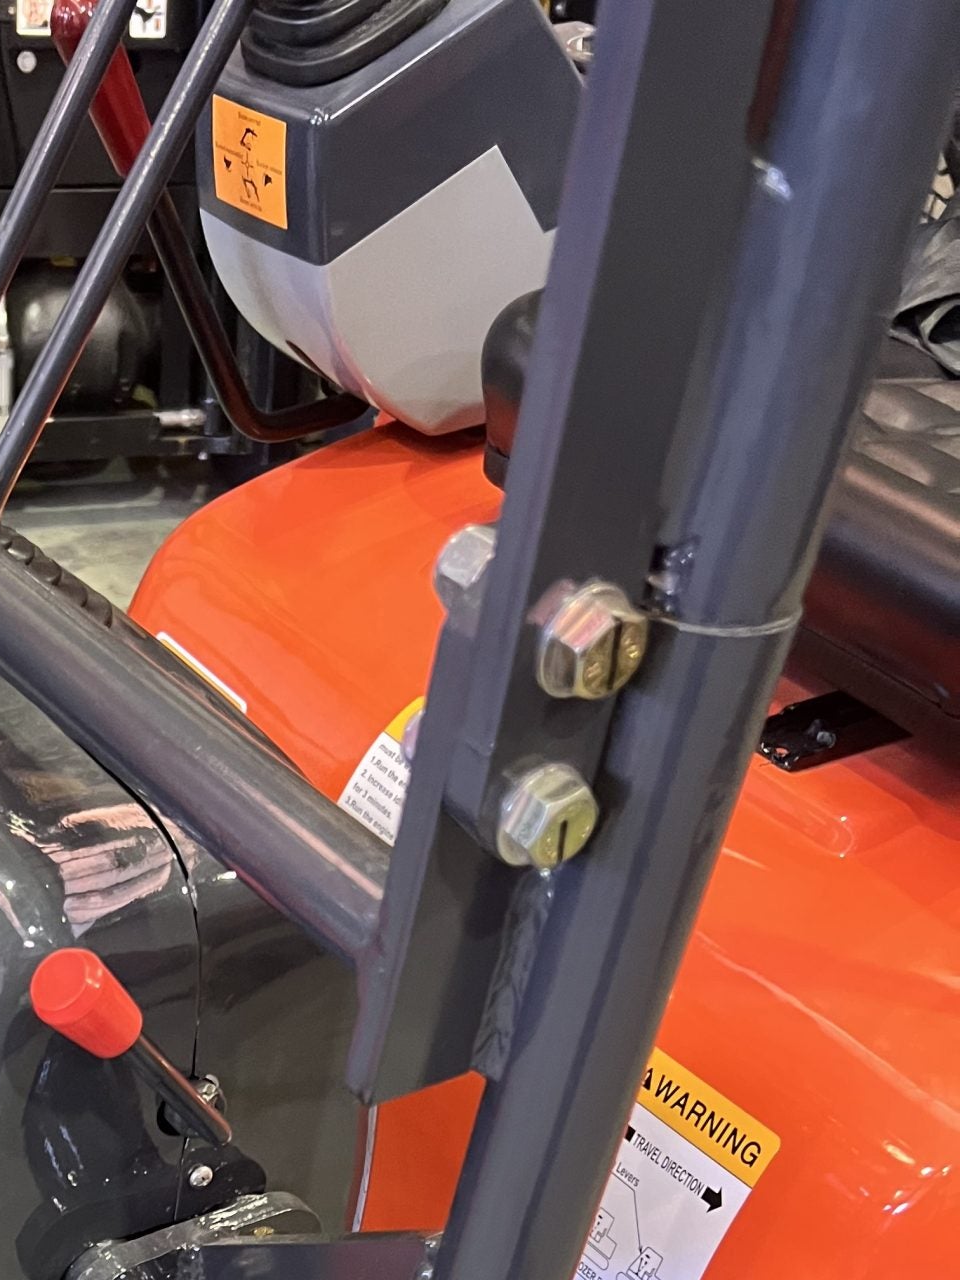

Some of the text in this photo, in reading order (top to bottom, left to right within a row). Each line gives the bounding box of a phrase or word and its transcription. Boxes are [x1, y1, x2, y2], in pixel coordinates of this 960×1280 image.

[388, 770, 399, 783] the
[353, 782, 363, 794] for
[361, 790, 369, 799] 3
[362, 811, 373, 824] the
[373, 821, 394, 841] engine
[655, 1074, 761, 1168] WARNING
[616, 1162, 640, 1187] Levers
[633, 1133, 705, 1197] TRAVEL DIRECTION
